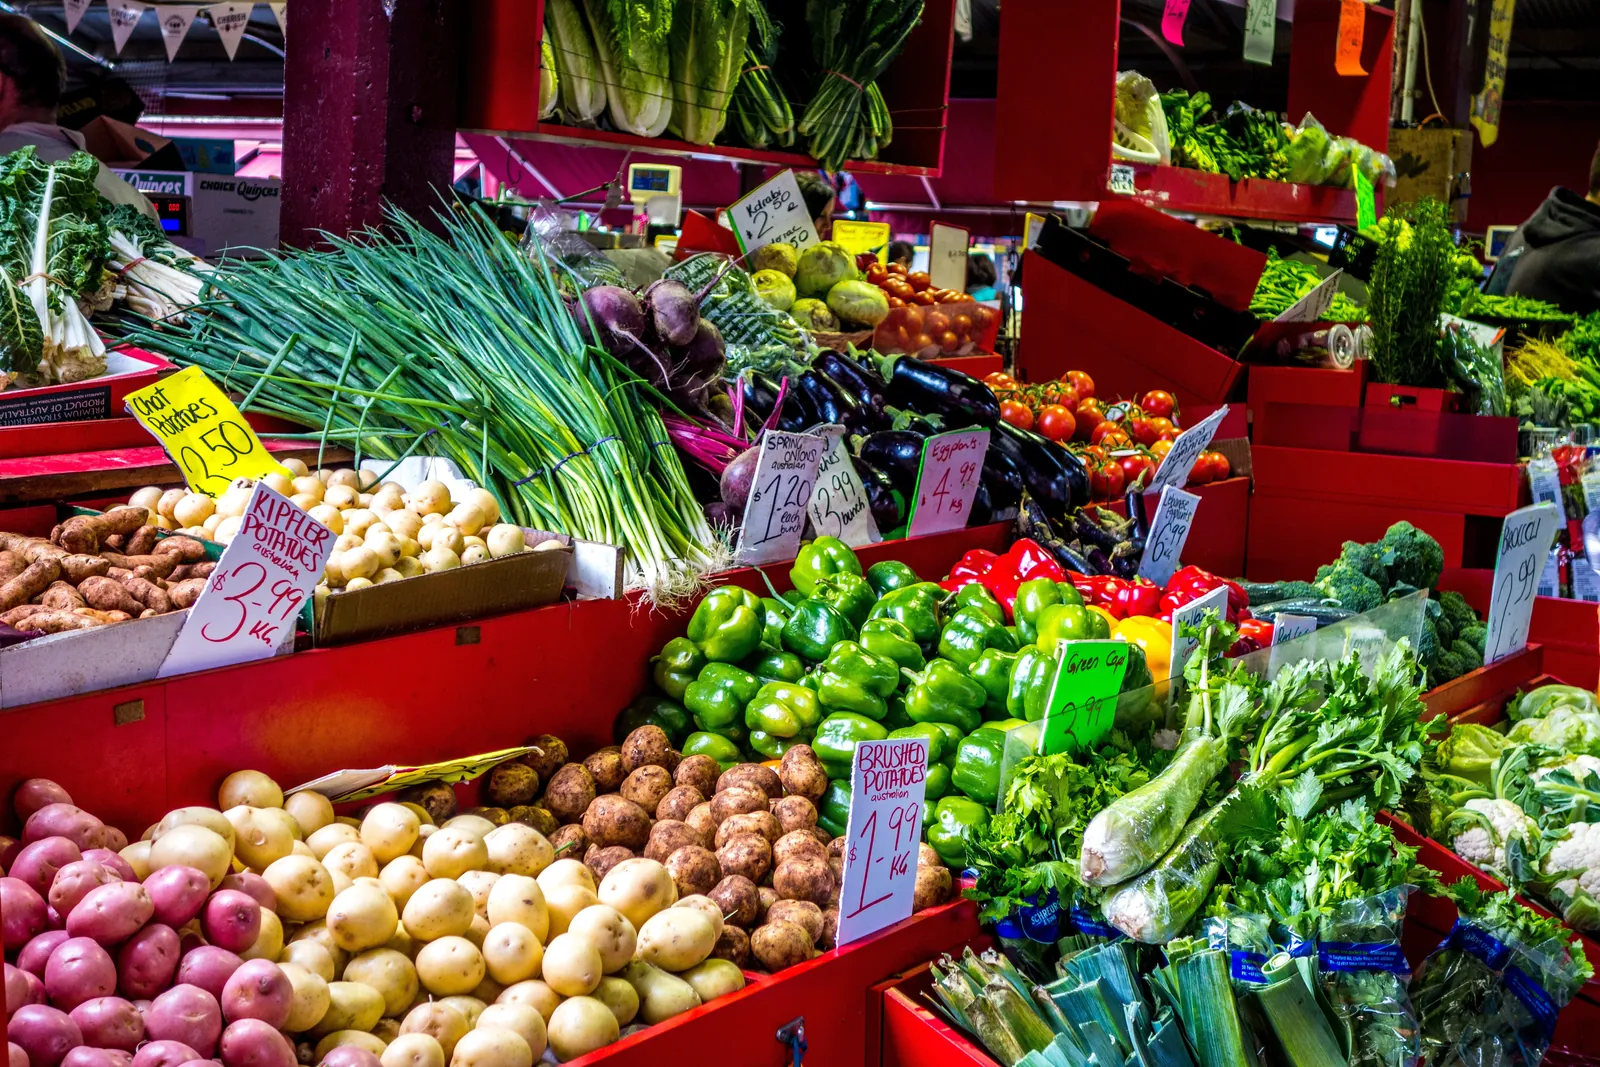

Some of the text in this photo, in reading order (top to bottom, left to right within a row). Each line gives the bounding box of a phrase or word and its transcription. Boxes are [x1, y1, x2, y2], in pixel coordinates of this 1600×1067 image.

[216, 12, 247, 25] CHERISH
[200, 180, 279, 201] CHOICE Quinces
[50, 403, 63, 413] OF
[64, 398, 105, 411] PRODUCT
[133, 386, 171, 416] Chat
[63, 406, 105, 418] PREMIUM
[767, 436, 804, 451] SPRING
[784, 448, 817, 462] ONIONS
[771, 461, 806, 471] australian
[780, 507, 800, 524] each
[840, 496, 866, 526] bunch
[253, 490, 330, 554] KIPFLER
[779, 523, 801, 535] bunch
[242, 513, 322, 573] POTATOES
[252, 543, 300, 581] australian
[1067, 652, 1099, 675] Green
[858, 742, 926, 772] BRUSHED
[863, 765, 926, 796] POTATOES
[870, 789, 910, 802] australian
